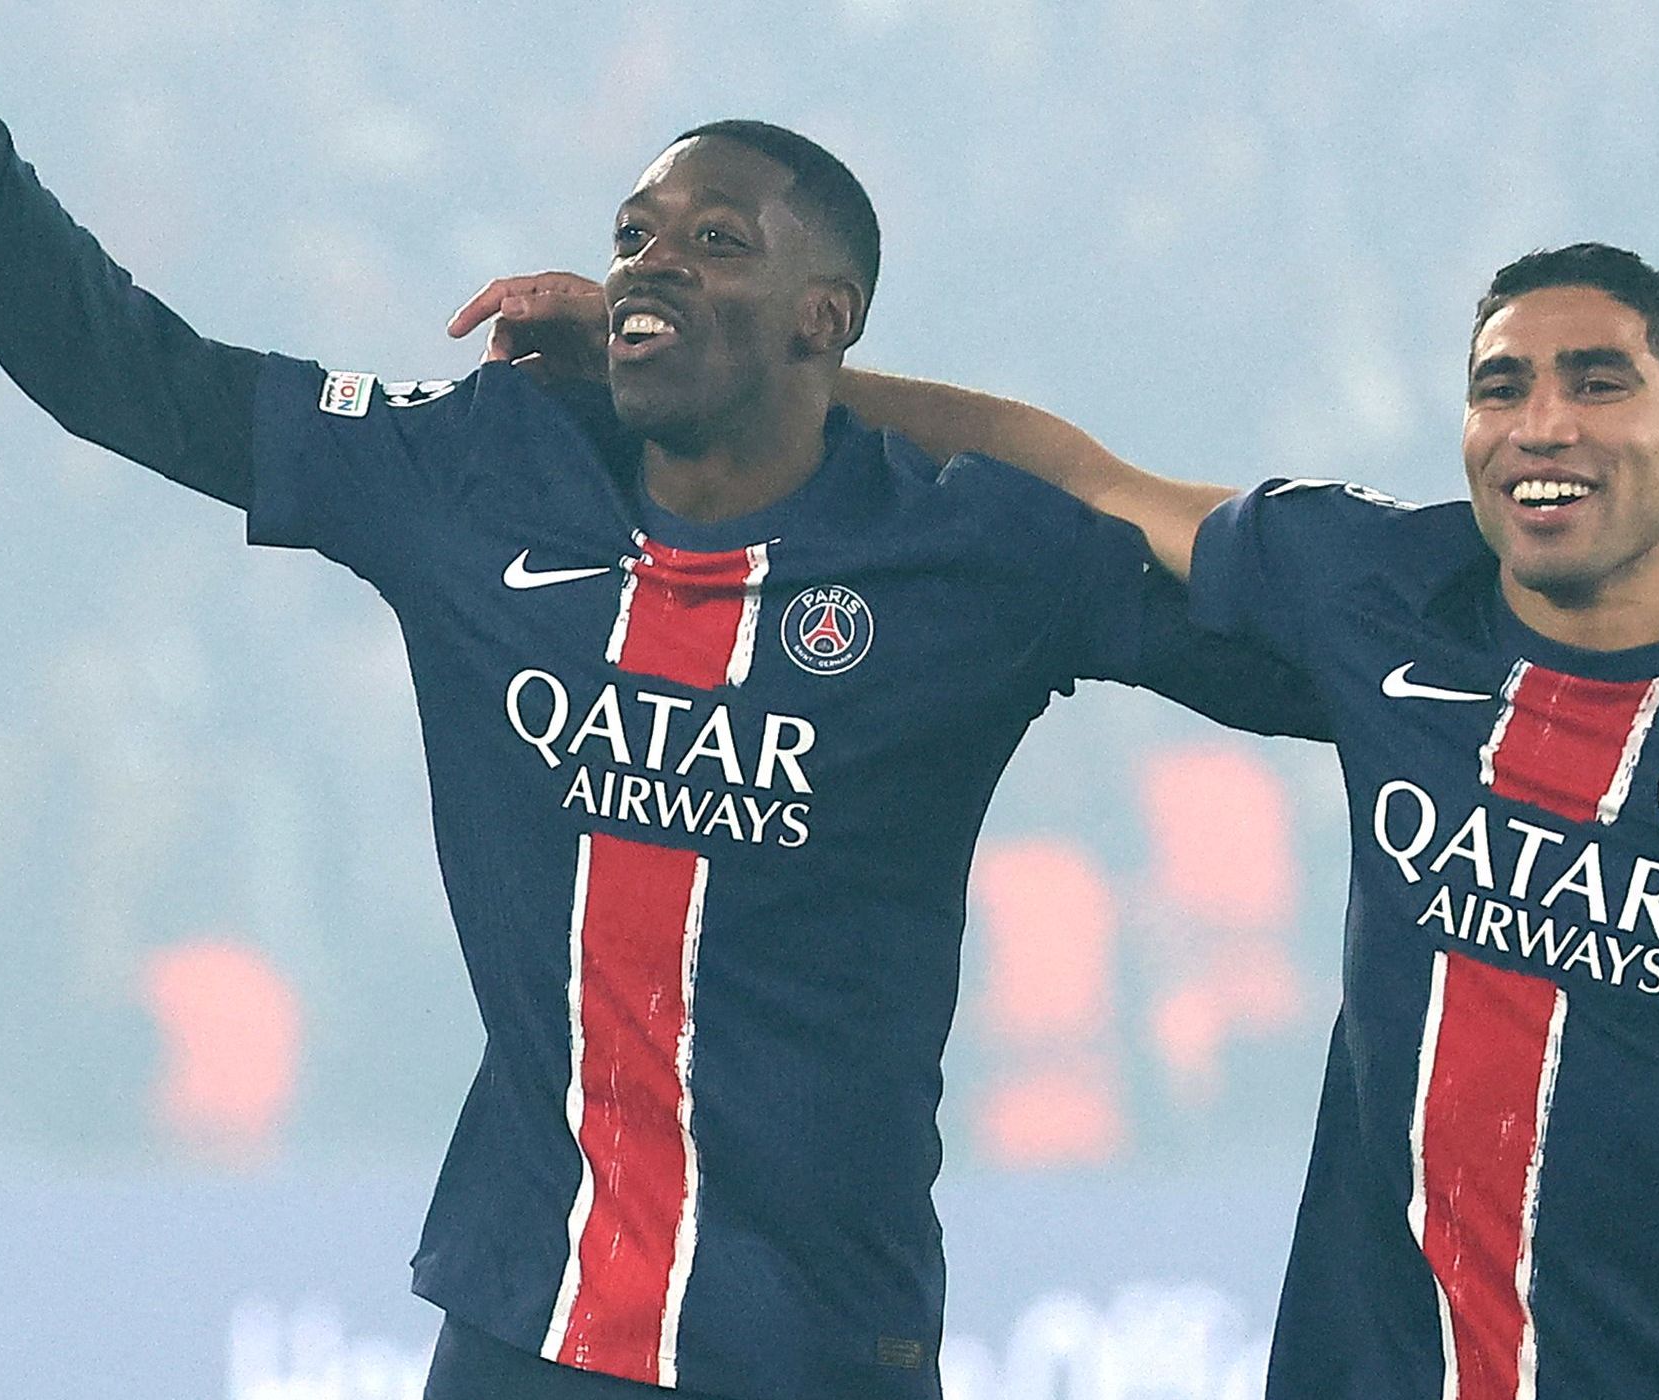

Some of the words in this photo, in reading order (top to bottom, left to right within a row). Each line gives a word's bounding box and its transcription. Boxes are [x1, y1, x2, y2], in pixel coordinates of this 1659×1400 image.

[801, 589, 862, 615] PARIS
[506, 669, 816, 793] QATAR
[561, 765, 810, 848] AIRWAYS
